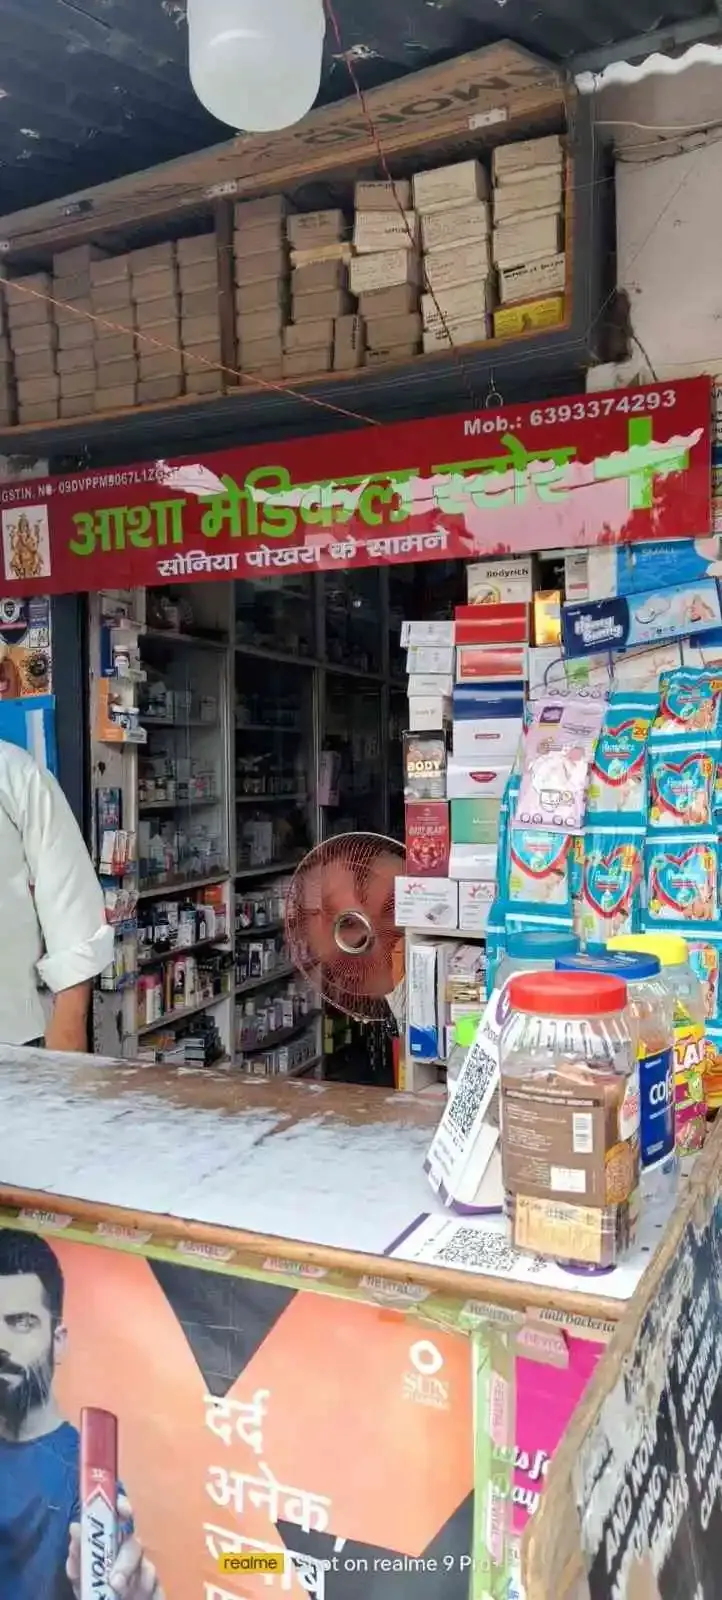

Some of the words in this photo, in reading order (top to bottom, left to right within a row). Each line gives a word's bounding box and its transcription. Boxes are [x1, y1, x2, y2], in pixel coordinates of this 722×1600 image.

[464, 416, 522, 437] Mob.:
[530, 390, 677, 427] 6393374293
[69, 499, 187, 556] आशा
[199, 465, 419, 538] मेडिकल
[156, 550, 238, 578] सोनिया
[367, 524, 449, 558] सामने
[407, 760, 441, 772] BODY
[203, 1389, 270, 1454] दर्द
